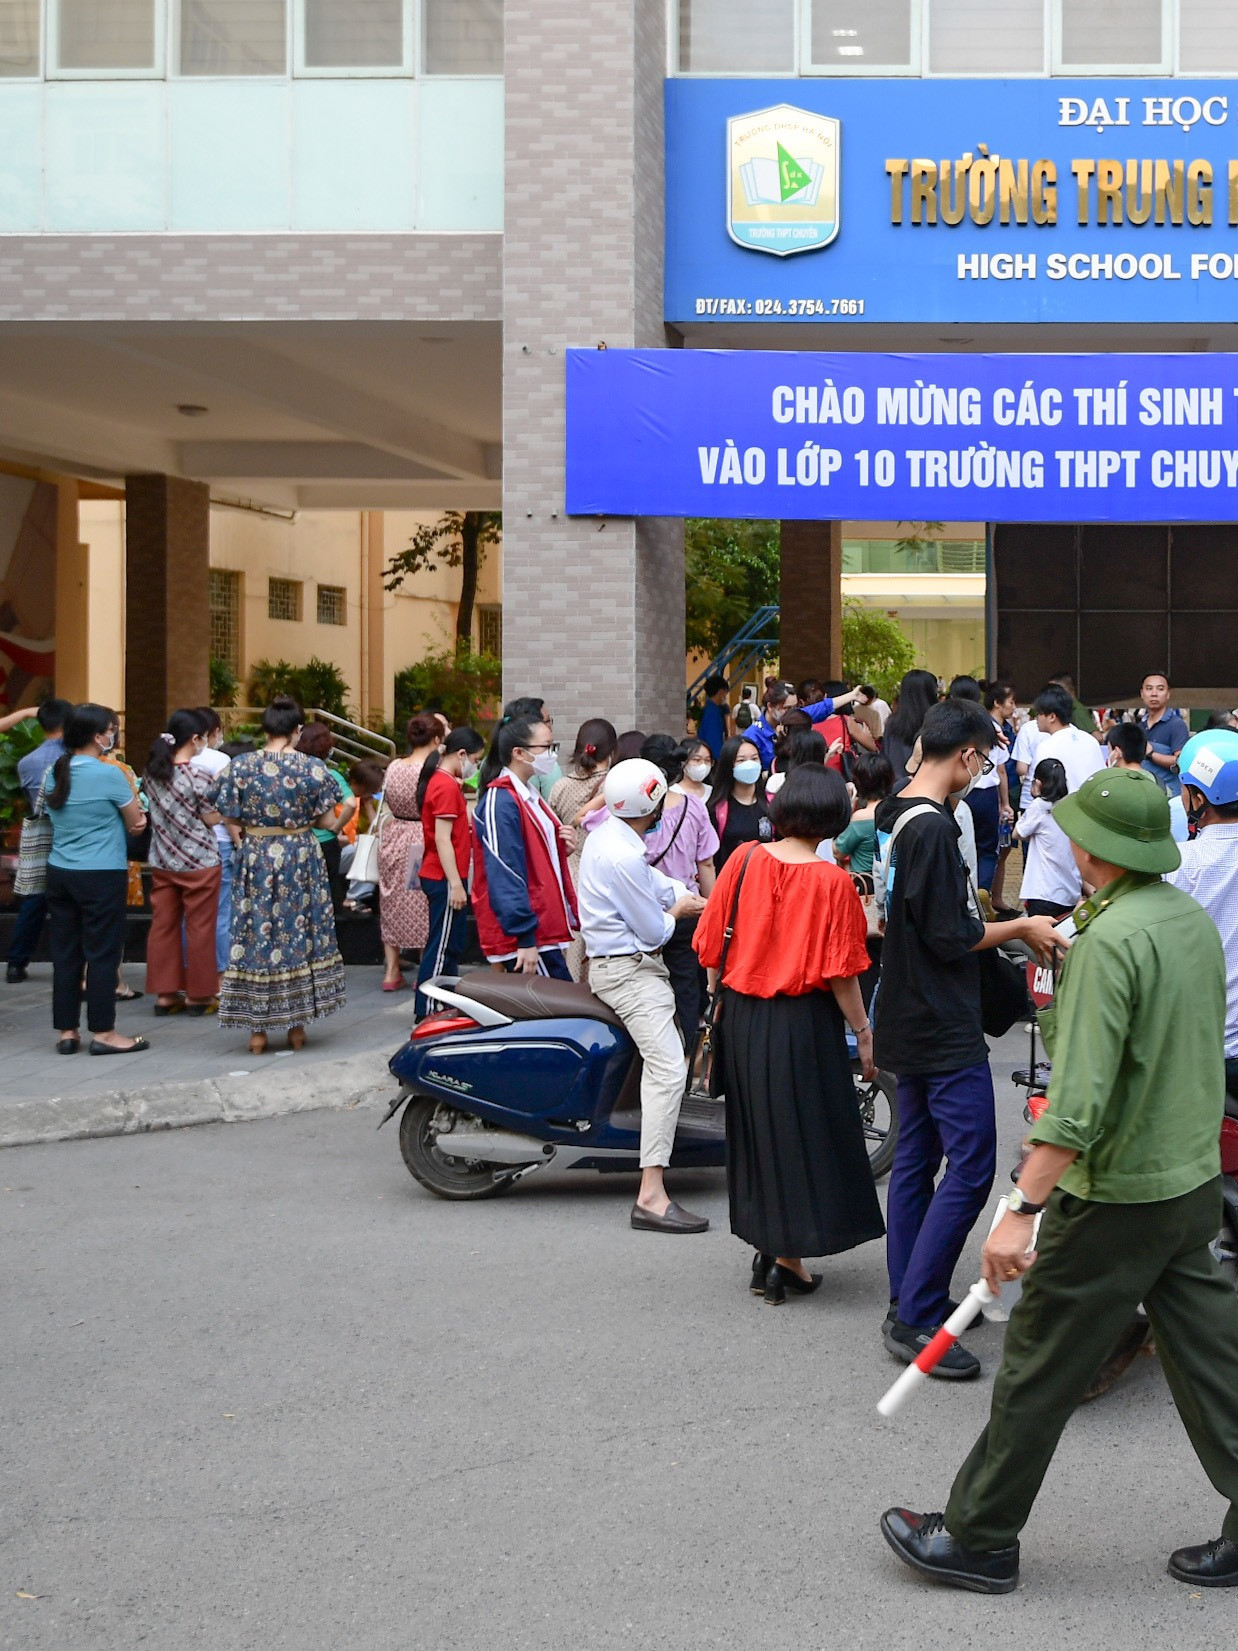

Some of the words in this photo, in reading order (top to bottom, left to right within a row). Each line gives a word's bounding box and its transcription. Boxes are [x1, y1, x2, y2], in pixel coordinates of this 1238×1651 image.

[1058, 97, 1131, 133] ĐẠI
[1141, 96, 1228, 132] HỌC
[885, 143, 1058, 226] TRƯỜNG
[1071, 158, 1214, 226] TRUNG
[957, 253, 1037, 280] HIGH
[1046, 253, 1182, 280] SCHOOL
[695, 298, 752, 315] ĐT/FAX:
[755, 298, 865, 316] 024.3754.7661
[772, 378, 865, 425] CHÀO
[877, 380, 981, 426] MỪNG
[993, 380, 1063, 426] CÁC
[1073, 380, 1128, 426] THÍ
[1139, 387, 1223, 426] SINH
[698, 439, 766, 486] VÀO
[777, 440, 842, 487] LỚP
[854, 449, 895, 487] 10
[905, 440, 1044, 488] TRƯỜNG
[1055, 450, 1141, 488] THPT
[1196, 759, 1214, 774] UBER
